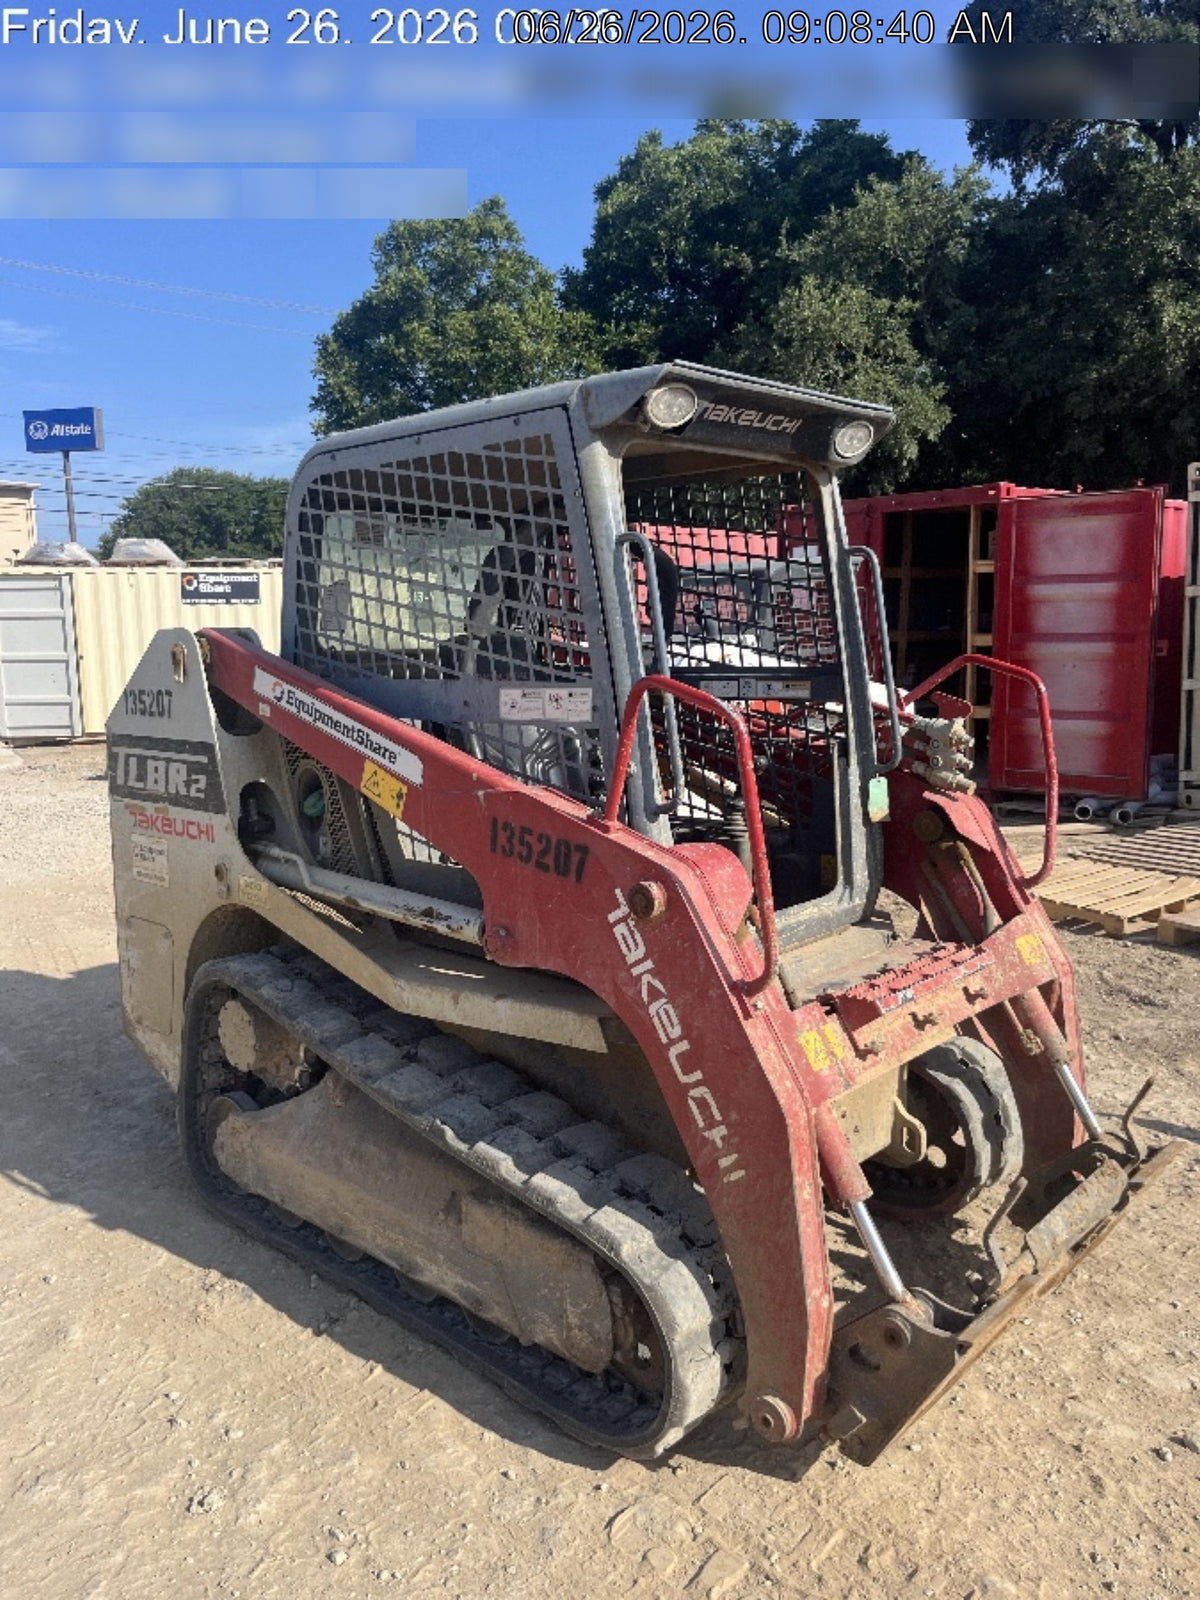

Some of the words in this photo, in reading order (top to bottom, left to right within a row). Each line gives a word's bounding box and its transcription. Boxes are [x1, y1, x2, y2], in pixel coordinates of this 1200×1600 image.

[50, 423, 92, 436] Allstate
[198, 573, 259, 584] Equipment
[199, 583, 232, 593] Share
[124, 689, 173, 720] 135207
[287, 689, 397, 765] EquipmentShare
[489, 816, 590, 883] 135207
